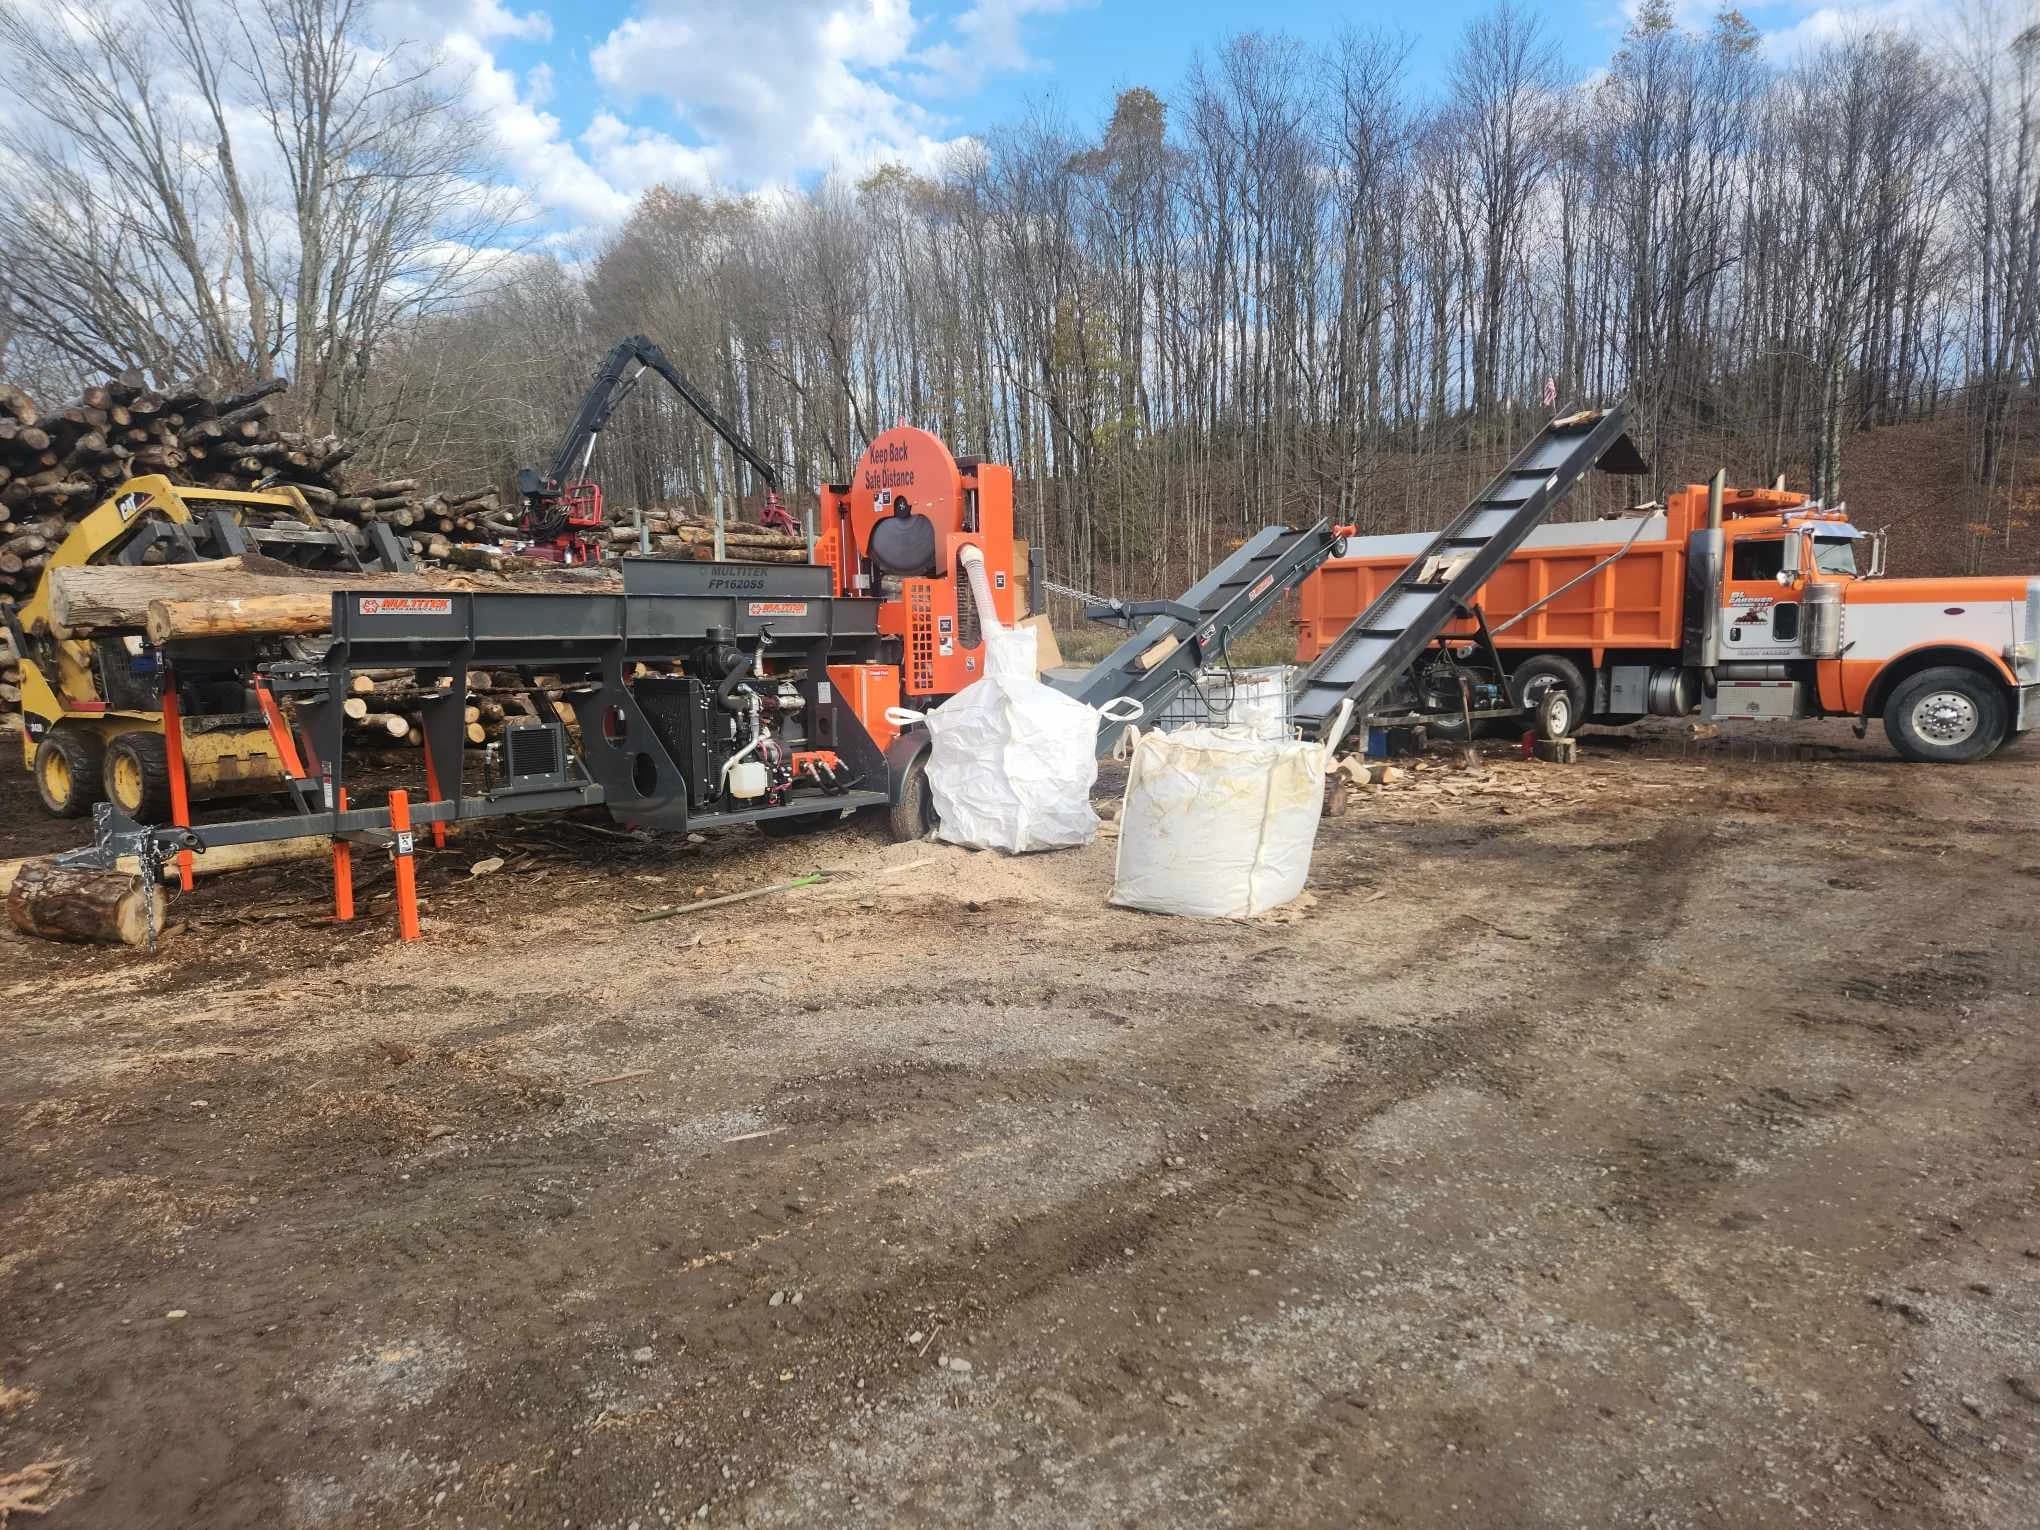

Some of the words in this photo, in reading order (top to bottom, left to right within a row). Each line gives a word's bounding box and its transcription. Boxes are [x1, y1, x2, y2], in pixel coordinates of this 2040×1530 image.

[870, 444, 888, 468] Keep
[890, 440, 908, 461] Back
[865, 469, 880, 490] Safe
[882, 467, 914, 488] Distance
[711, 566, 769, 577] MULTITEK
[708, 579, 765, 589] FP1620SS
[382, 598, 448, 608] MULTITEK
